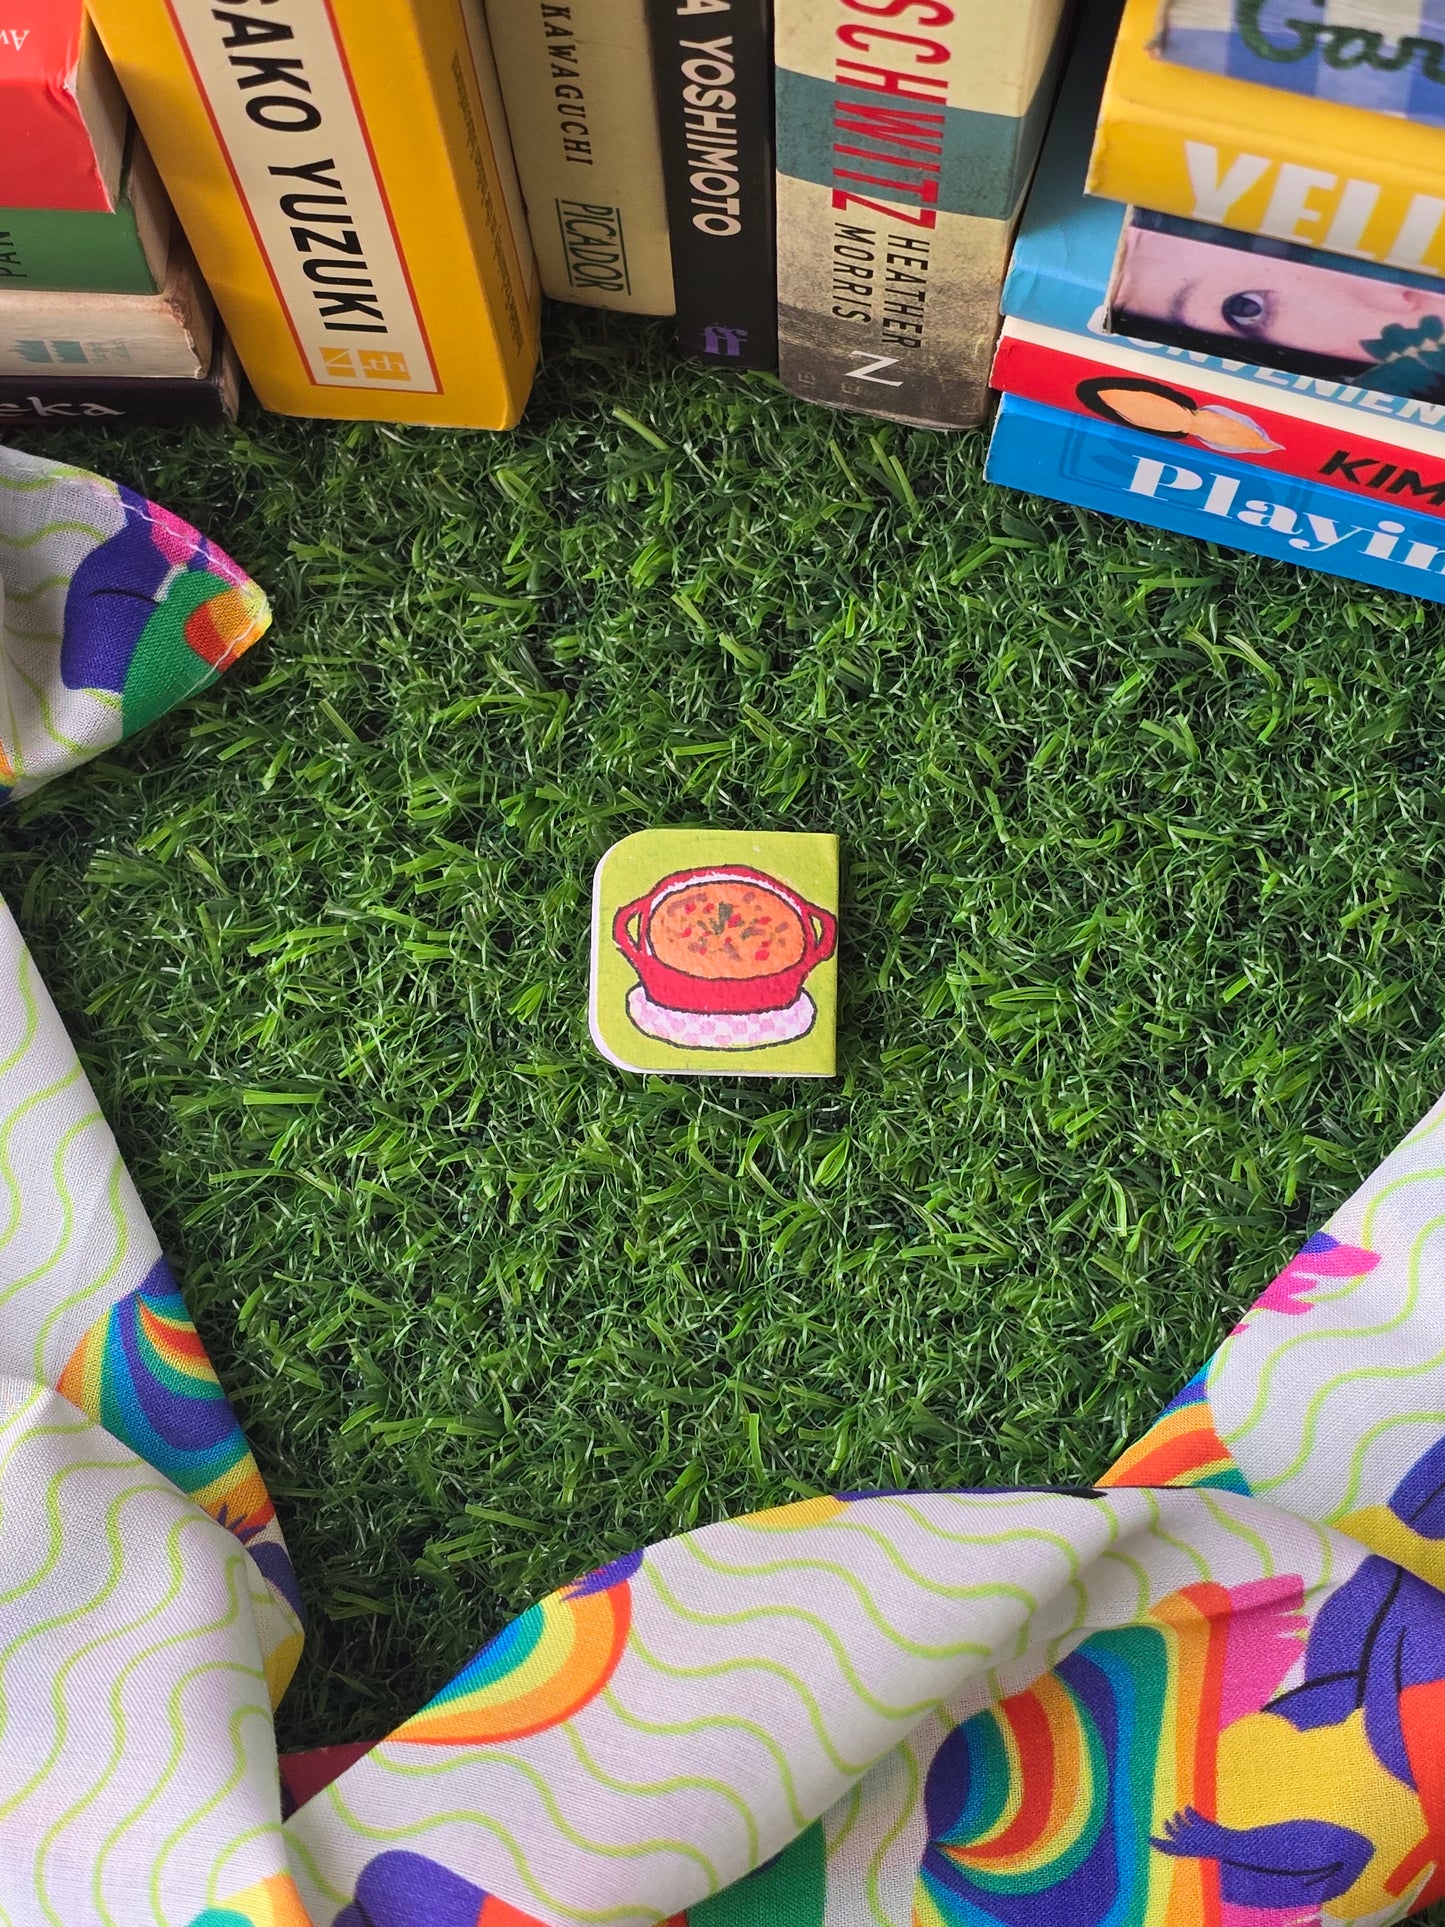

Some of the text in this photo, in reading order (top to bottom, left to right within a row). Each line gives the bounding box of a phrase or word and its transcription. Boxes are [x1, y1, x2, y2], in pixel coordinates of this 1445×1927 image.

[541, 3, 593, 166] KAWAGUCHI
[679, 36, 742, 236] YOSHIMOTO
[211, 0, 388, 334] AKO YUZUKI
[559, 200, 625, 294] PICADOR
[832, 222, 876, 323] MORRIS
[882, 234, 930, 349] HEATHER
